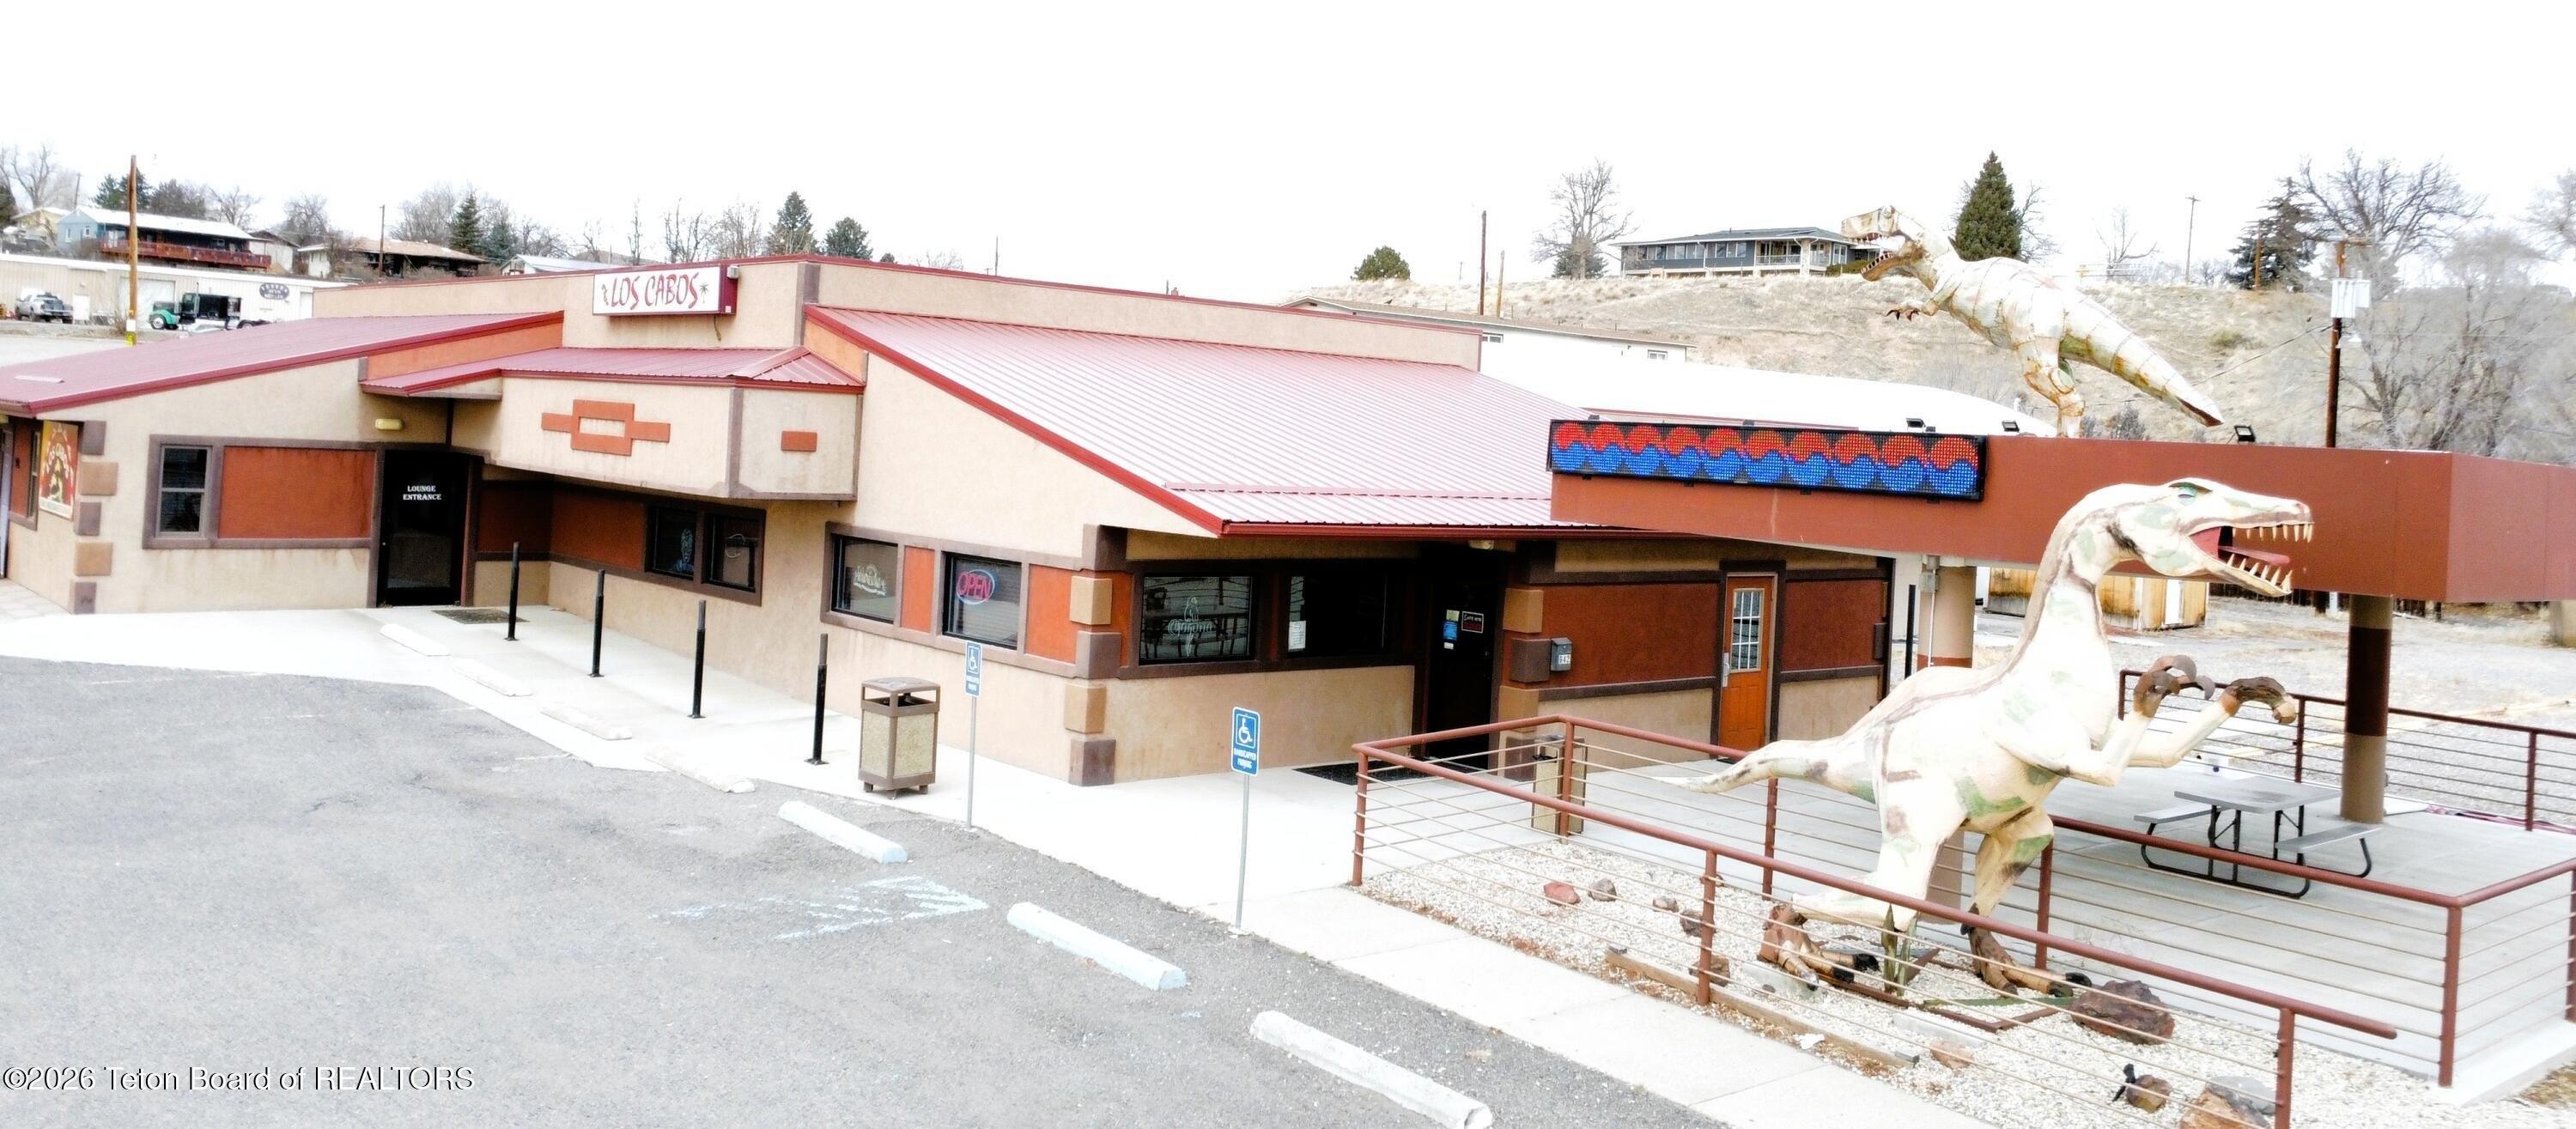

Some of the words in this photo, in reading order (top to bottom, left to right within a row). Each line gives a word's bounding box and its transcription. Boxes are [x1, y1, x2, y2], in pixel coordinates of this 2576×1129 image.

[611, 275, 641, 310] LOS
[644, 271, 699, 309] CABOS
[957, 571, 991, 600] OPEN
[1168, 618, 1212, 636] Corona
